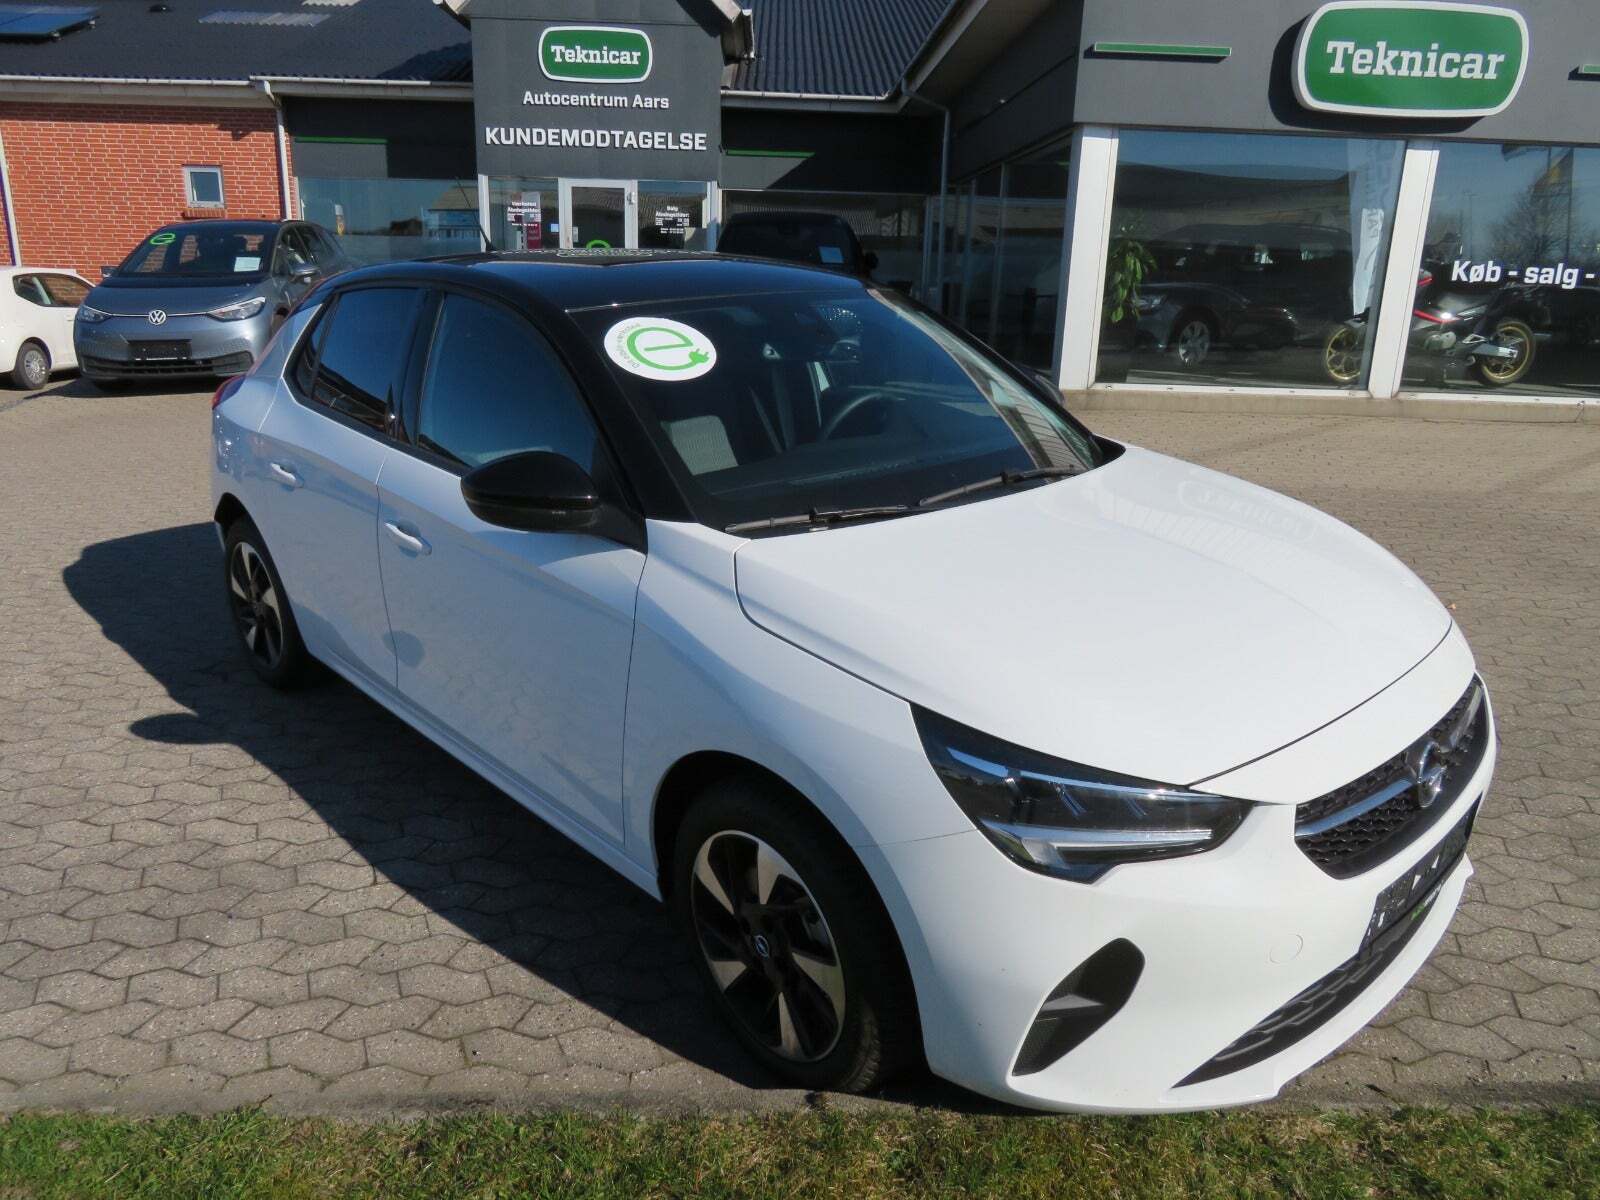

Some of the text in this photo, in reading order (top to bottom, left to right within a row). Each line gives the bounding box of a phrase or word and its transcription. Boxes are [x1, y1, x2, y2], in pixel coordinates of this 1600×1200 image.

[550, 45, 641, 65] Teknicar
[1326, 40, 1505, 80] Teknicar
[523, 91, 669, 109] Autocentrum Aars
[485, 127, 708, 150] KUNDEMODTAGELSE
[1451, 260, 1501, 283] Køb
[1523, 262, 1579, 289] salg
